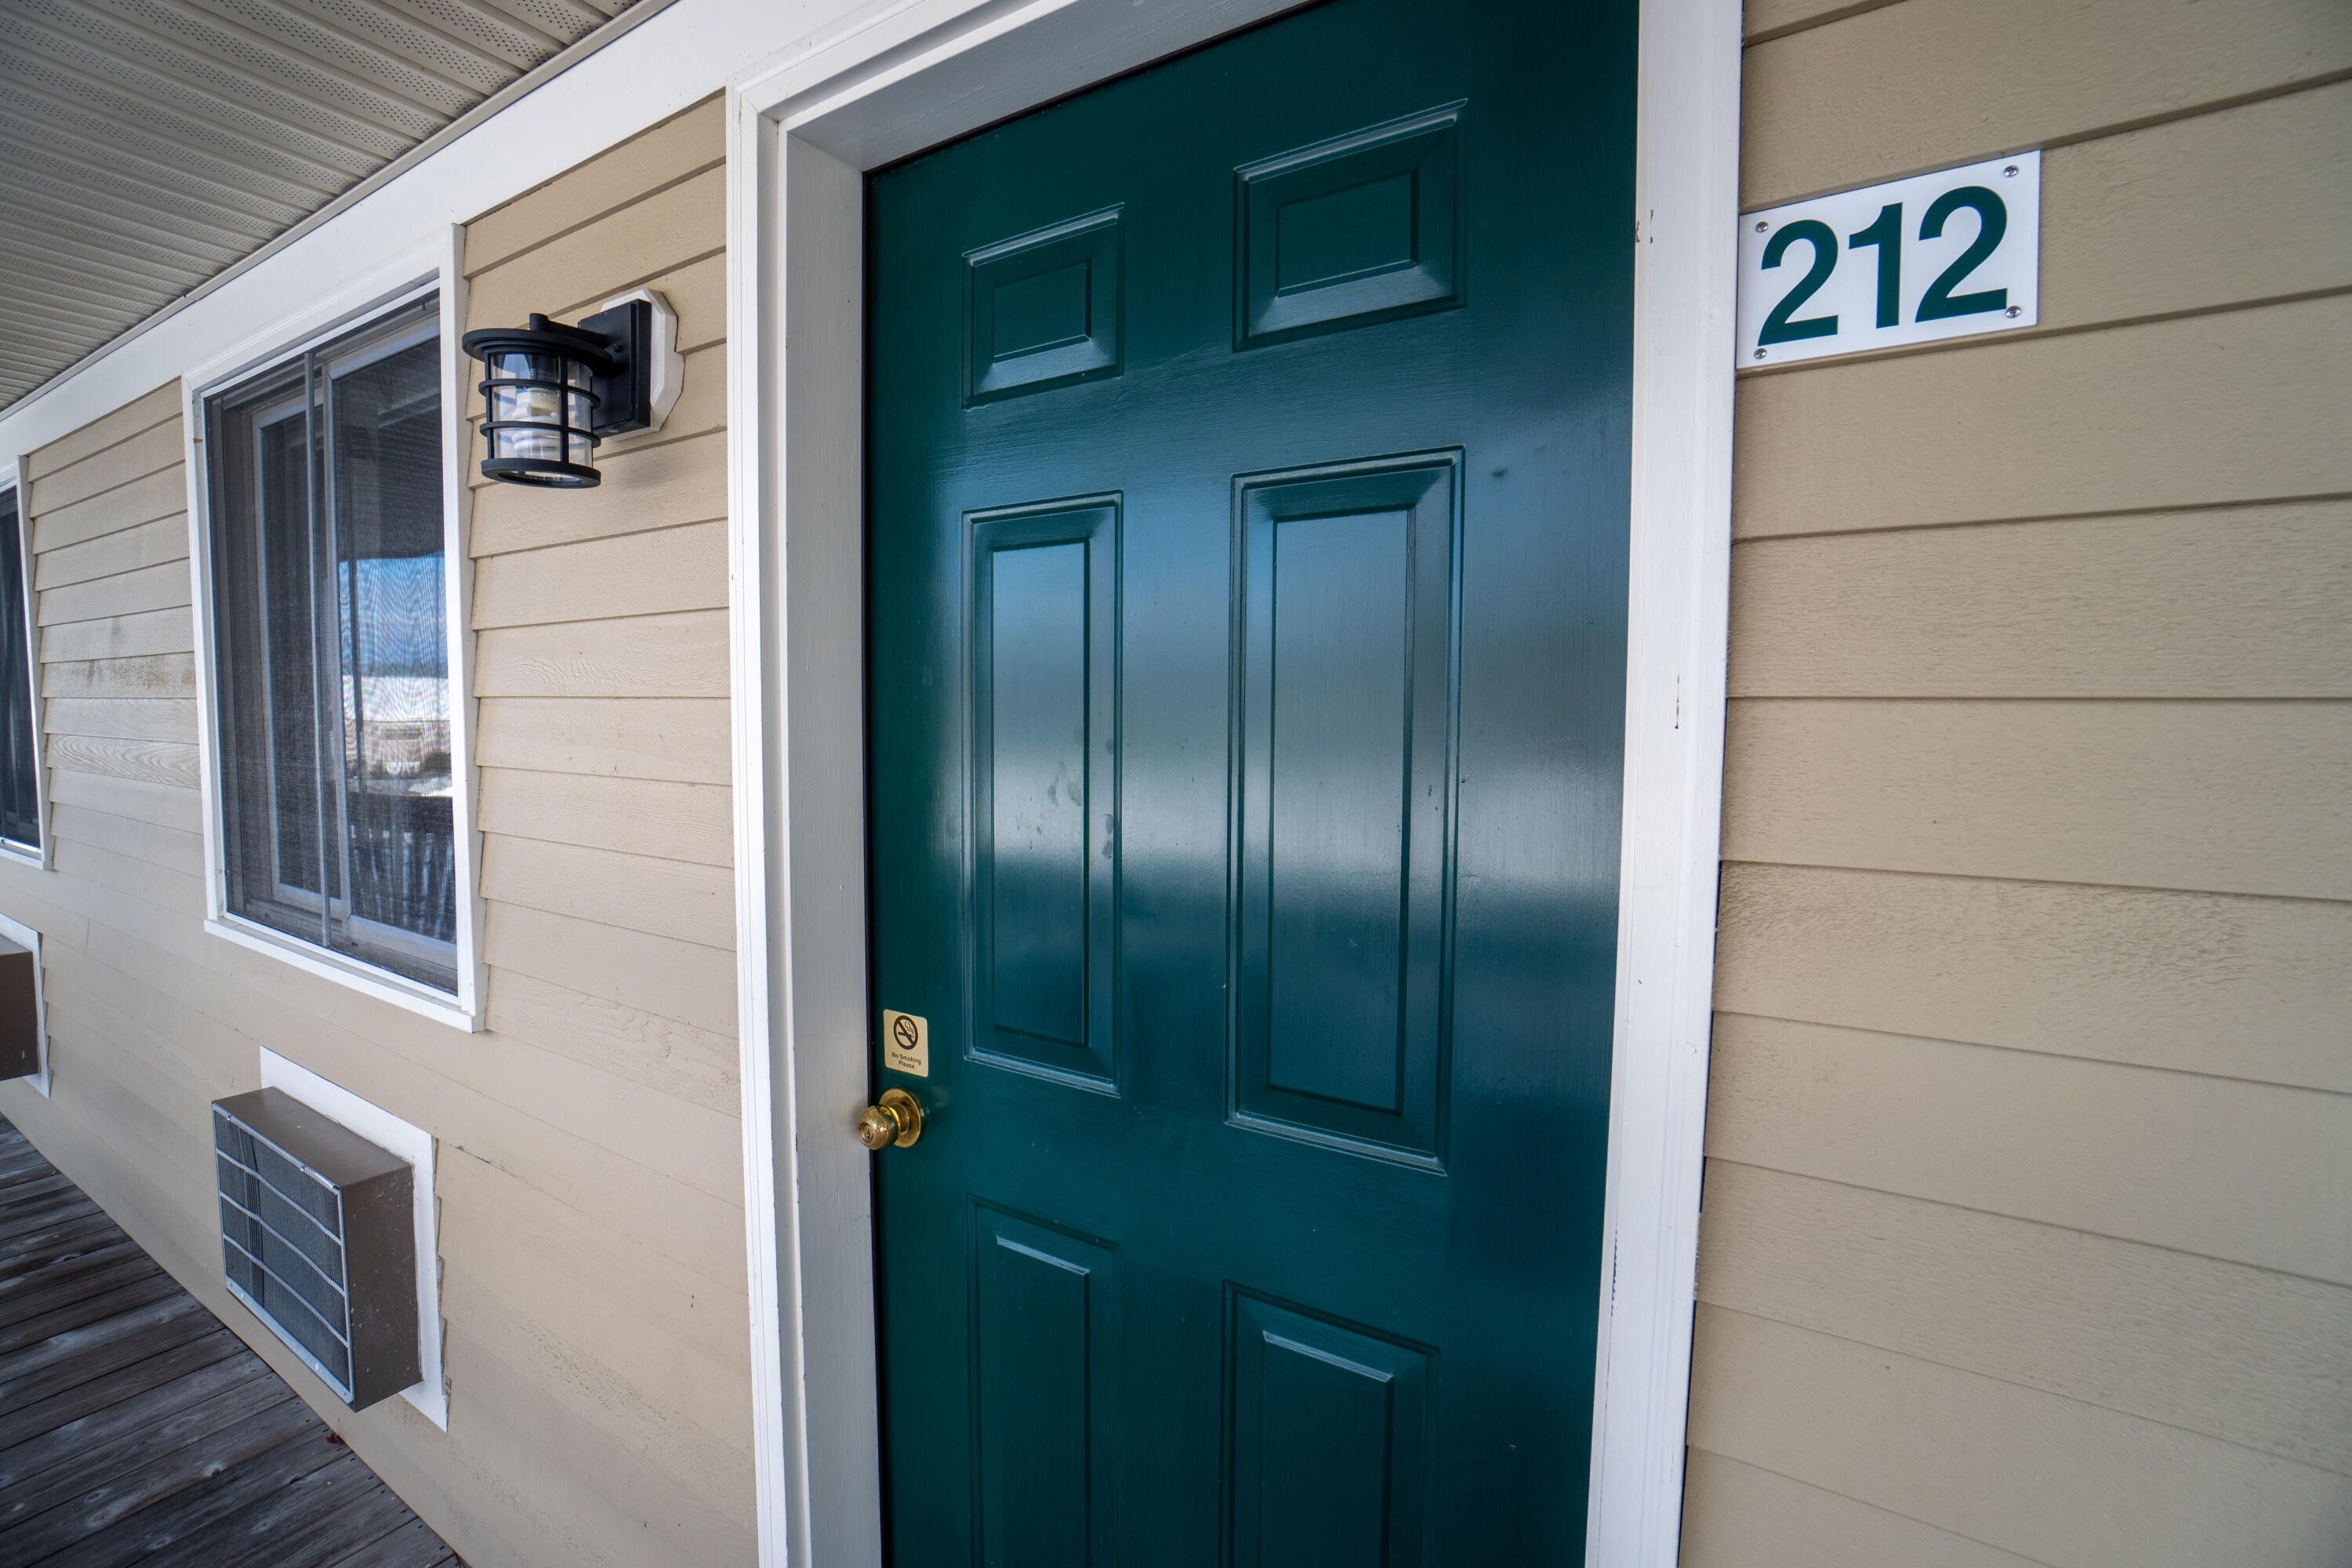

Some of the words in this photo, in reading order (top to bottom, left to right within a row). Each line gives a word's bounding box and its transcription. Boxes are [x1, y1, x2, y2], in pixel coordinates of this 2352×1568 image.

[1758, 186, 2008, 347] 212
[898, 1060, 915, 1069] Please
[899, 1054, 921, 1065] Smoking
